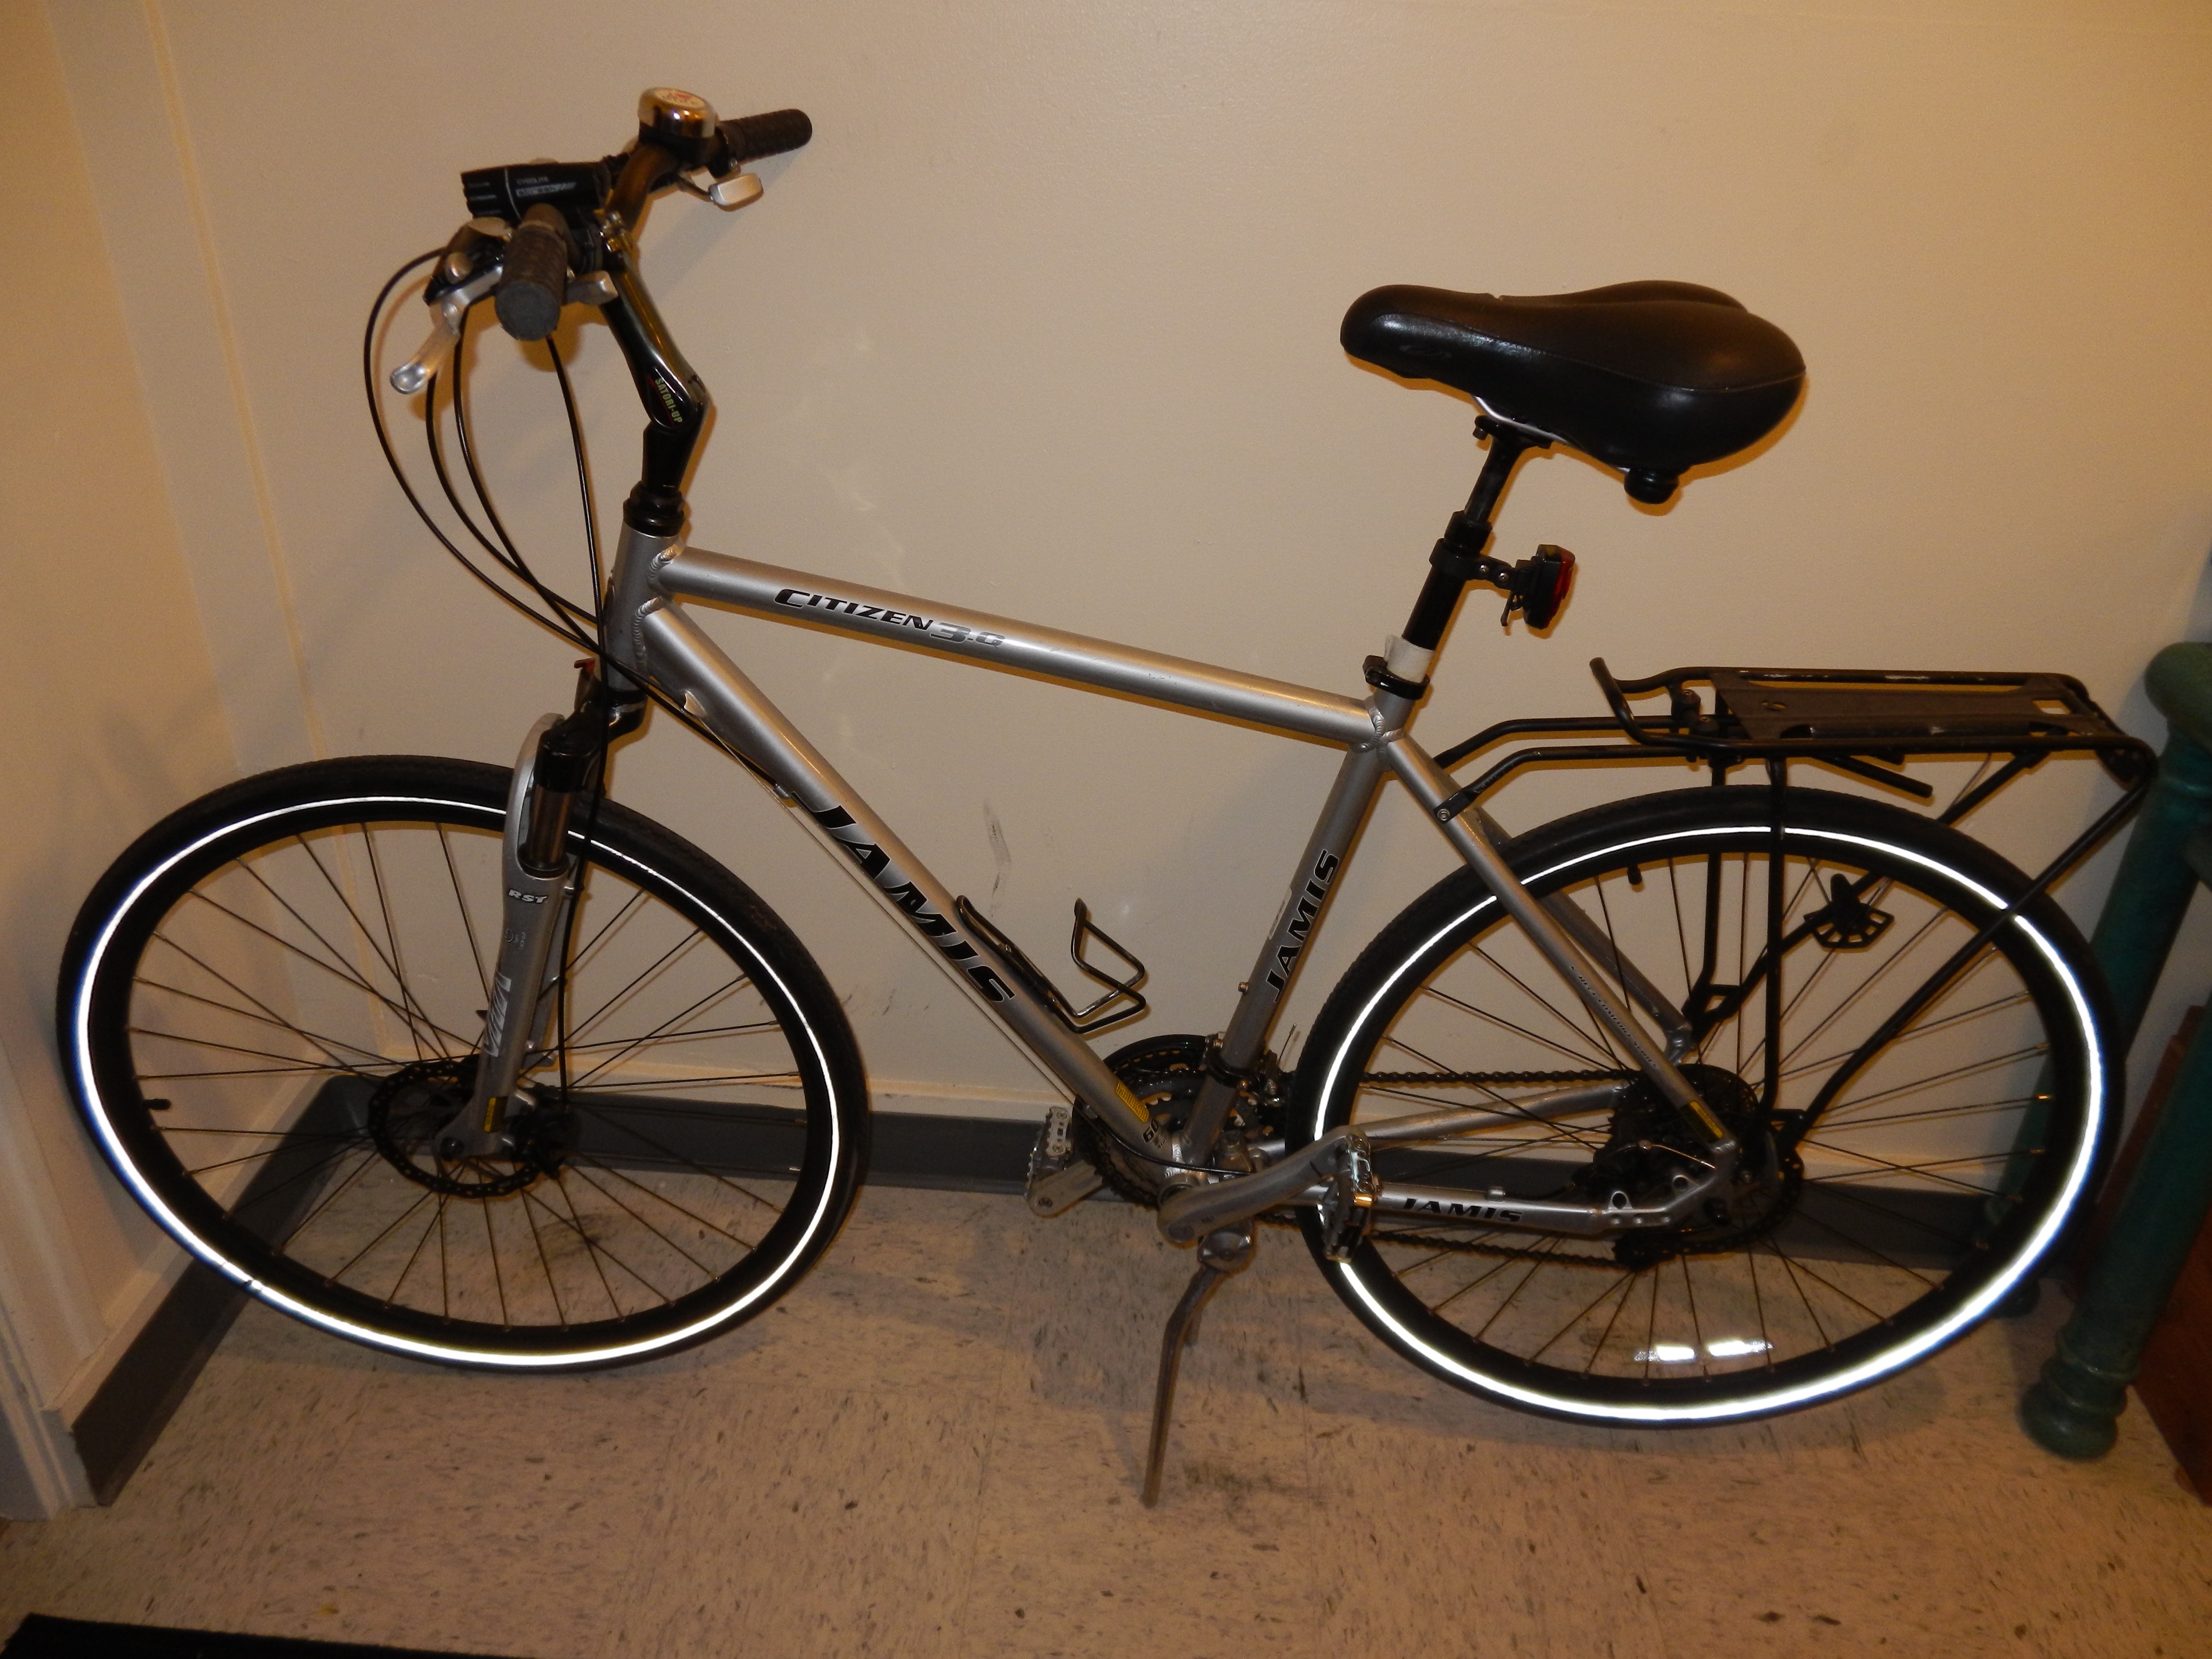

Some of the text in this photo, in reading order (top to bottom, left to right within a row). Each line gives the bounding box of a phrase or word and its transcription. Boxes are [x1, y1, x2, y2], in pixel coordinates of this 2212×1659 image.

[655, 378, 683, 422] SATORI-UP
[774, 589, 934, 631] CITIZEN
[508, 889, 548, 904] RST
[791, 791, 1016, 1002] JAMIS
[1265, 849, 1339, 1002] JAMIS
[1142, 1118, 1159, 1143] 60
[1403, 1198, 1524, 1223] JAMIS
